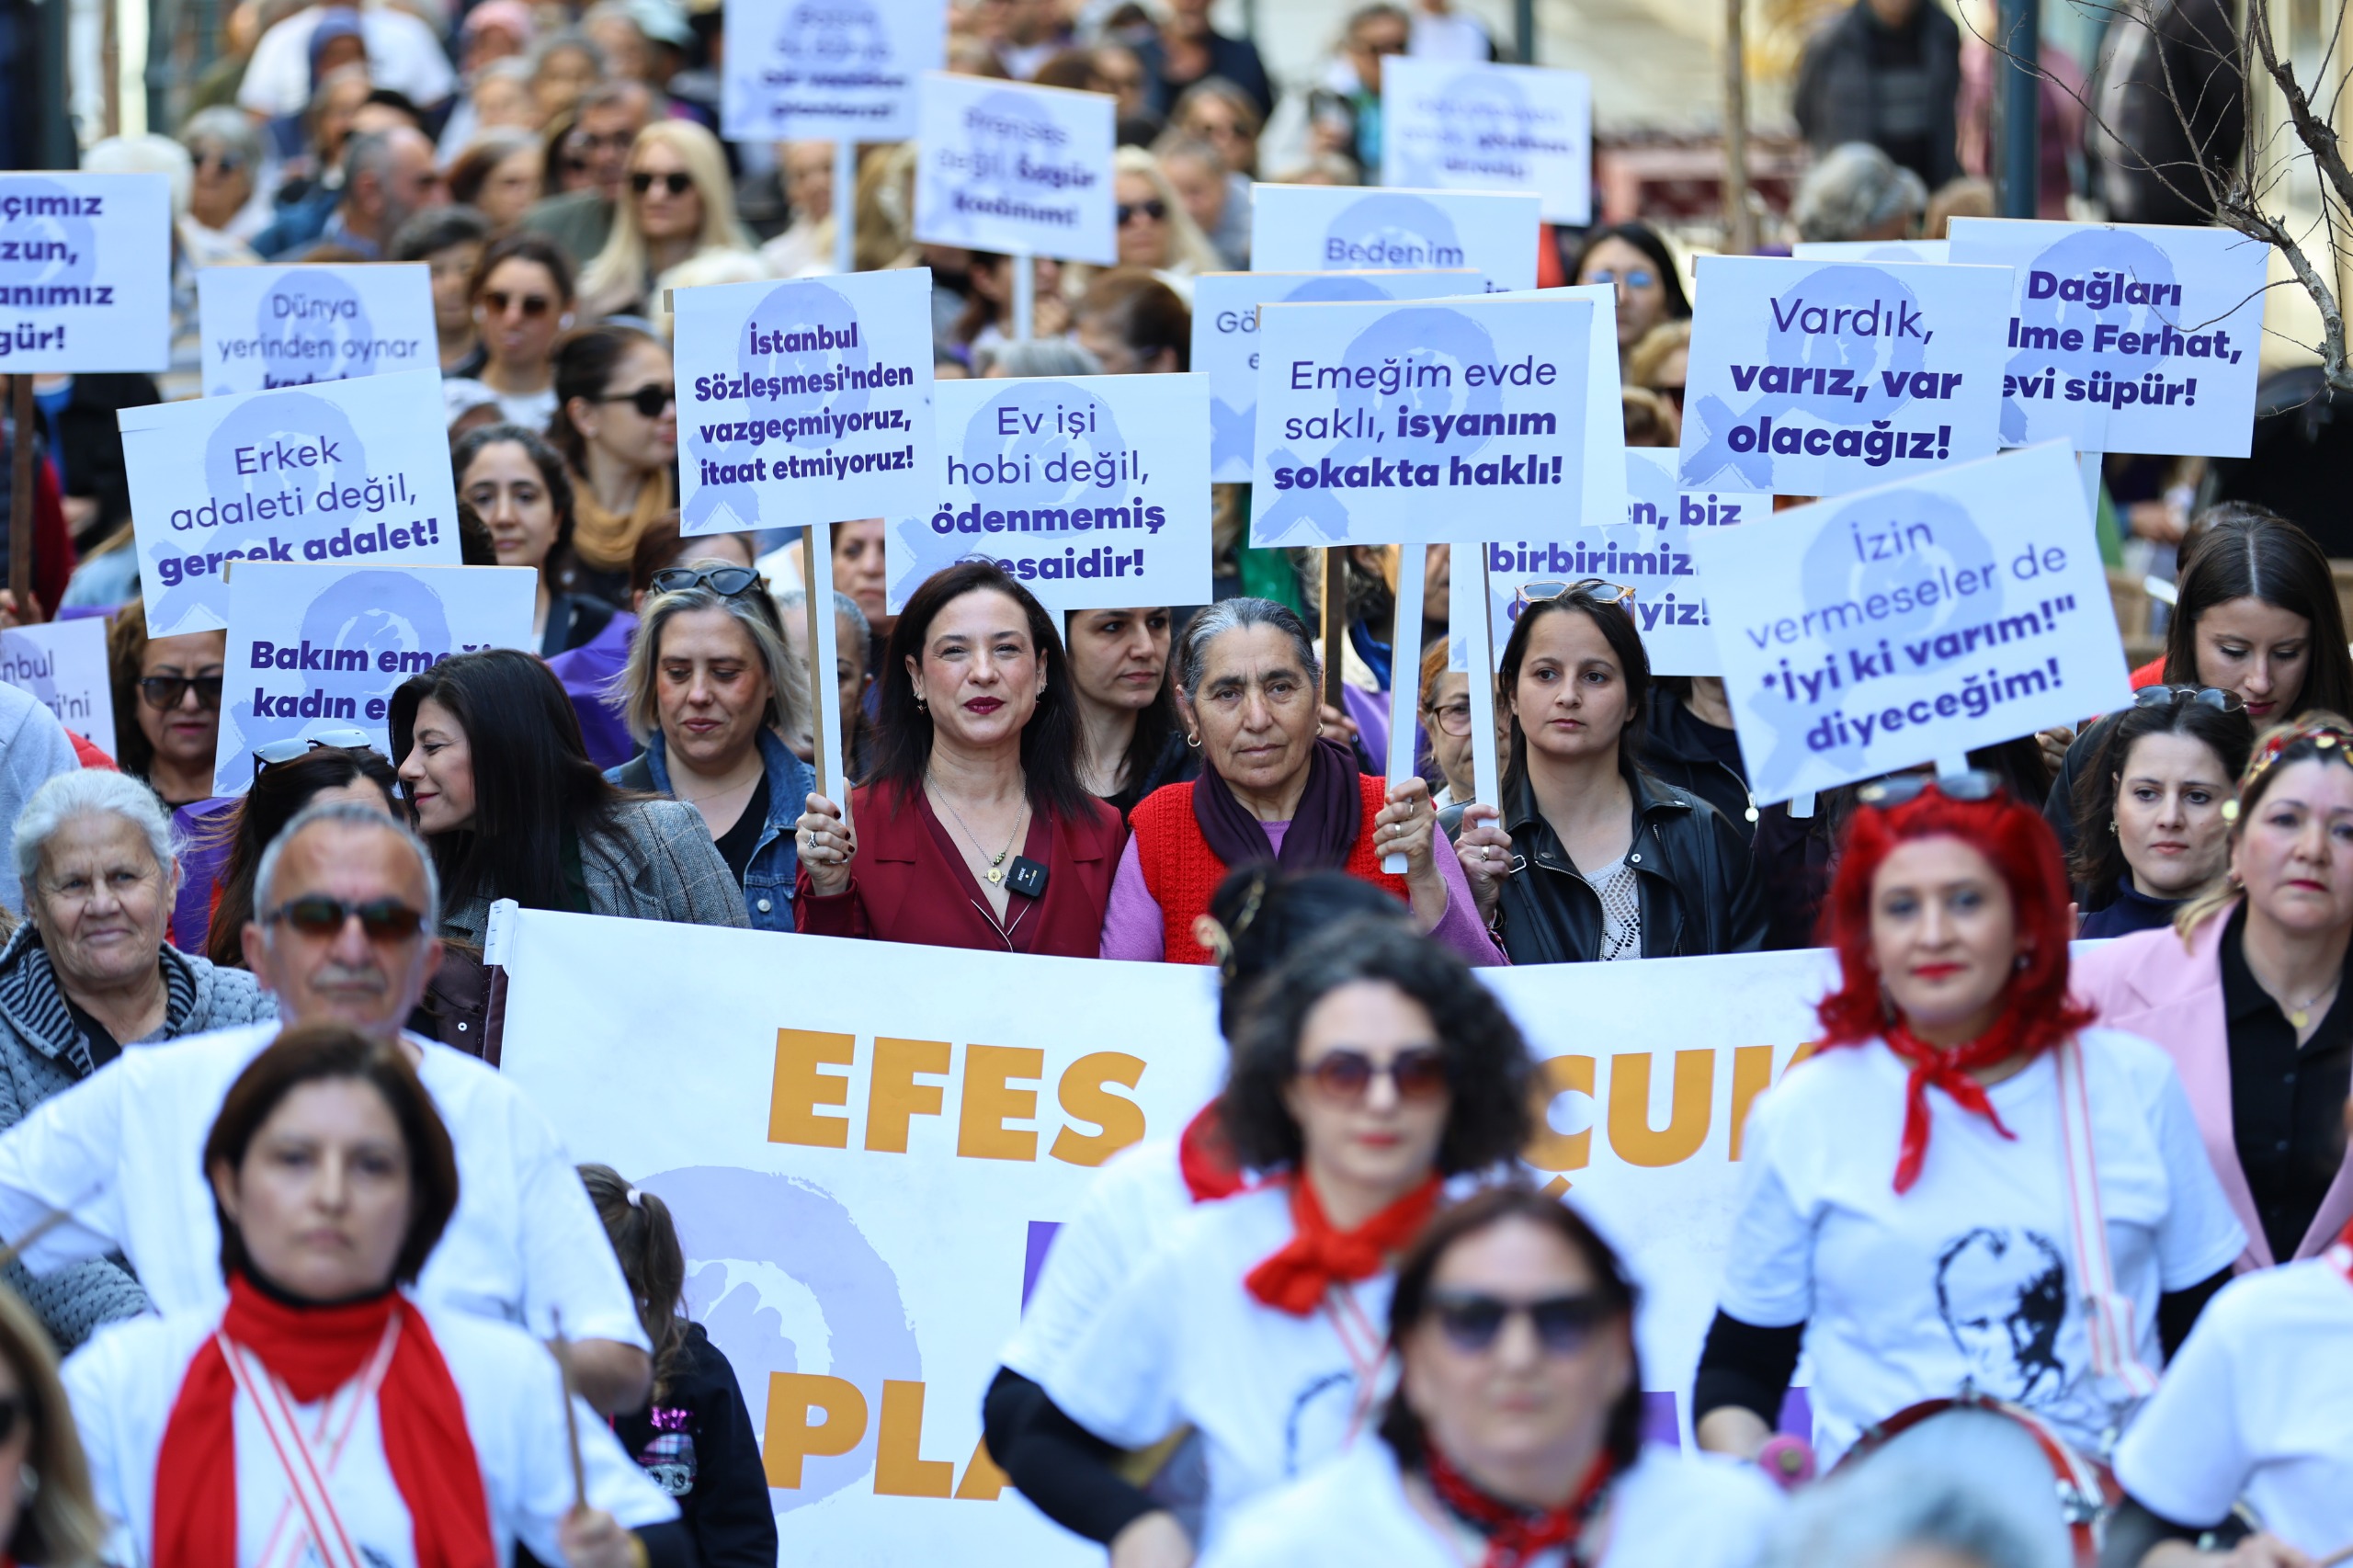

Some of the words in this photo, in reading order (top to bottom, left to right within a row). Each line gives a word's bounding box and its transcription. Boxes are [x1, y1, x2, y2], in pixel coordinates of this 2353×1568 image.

[1327, 238, 1463, 265] Bedenim
[273, 294, 358, 321] Dünya
[2029, 271, 2181, 310] Dağları
[751, 322, 858, 355] İstanbul
[1770, 297, 1933, 345] Vardık,
[218, 333, 335, 362] yerinden
[341, 338, 420, 363] oynar
[2093, 320, 2242, 364] Ferhat,
[696, 362, 913, 402] Sözleşmesi'nden
[1291, 358, 1450, 395] Emeğim
[1465, 355, 1556, 386] evde
[1731, 366, 1869, 403] varız,
[1881, 370, 1963, 399] var
[2064, 370, 2197, 410] süpür!
[700, 406, 912, 446] vazgeçmiyoruz,
[998, 407, 1043, 435] Ev
[1057, 403, 1095, 439] işi
[1286, 408, 1384, 443] saklı,
[1397, 405, 1556, 444] isyanım
[235, 436, 342, 475] Erkek
[1728, 416, 1951, 466] olacağız!
[701, 459, 767, 486] itaat
[773, 445, 914, 480] etmiyoruz!
[949, 454, 1029, 484] hobi
[1045, 450, 1148, 488] değil,
[1274, 457, 1439, 490] sokakta
[1449, 455, 1562, 485] haklı!
[171, 487, 302, 530] adaleti
[317, 473, 415, 512] değil,
[932, 497, 1165, 534] ödenmemiş
[1680, 494, 1741, 526] biz
[303, 518, 438, 561] adalet!
[1489, 541, 1699, 576] birbirimiz
[1851, 521, 1933, 561] İzin
[954, 546, 1143, 581] esaidir!
[1746, 562, 1996, 649] vermeseler
[2013, 544, 2065, 580] de
[251, 641, 368, 671] Bakım
[1849, 640, 1894, 681] ki
[253, 687, 356, 719] kadın
[1806, 657, 2063, 752] diyeceğim!
[767, 1028, 1146, 1166] EFES
